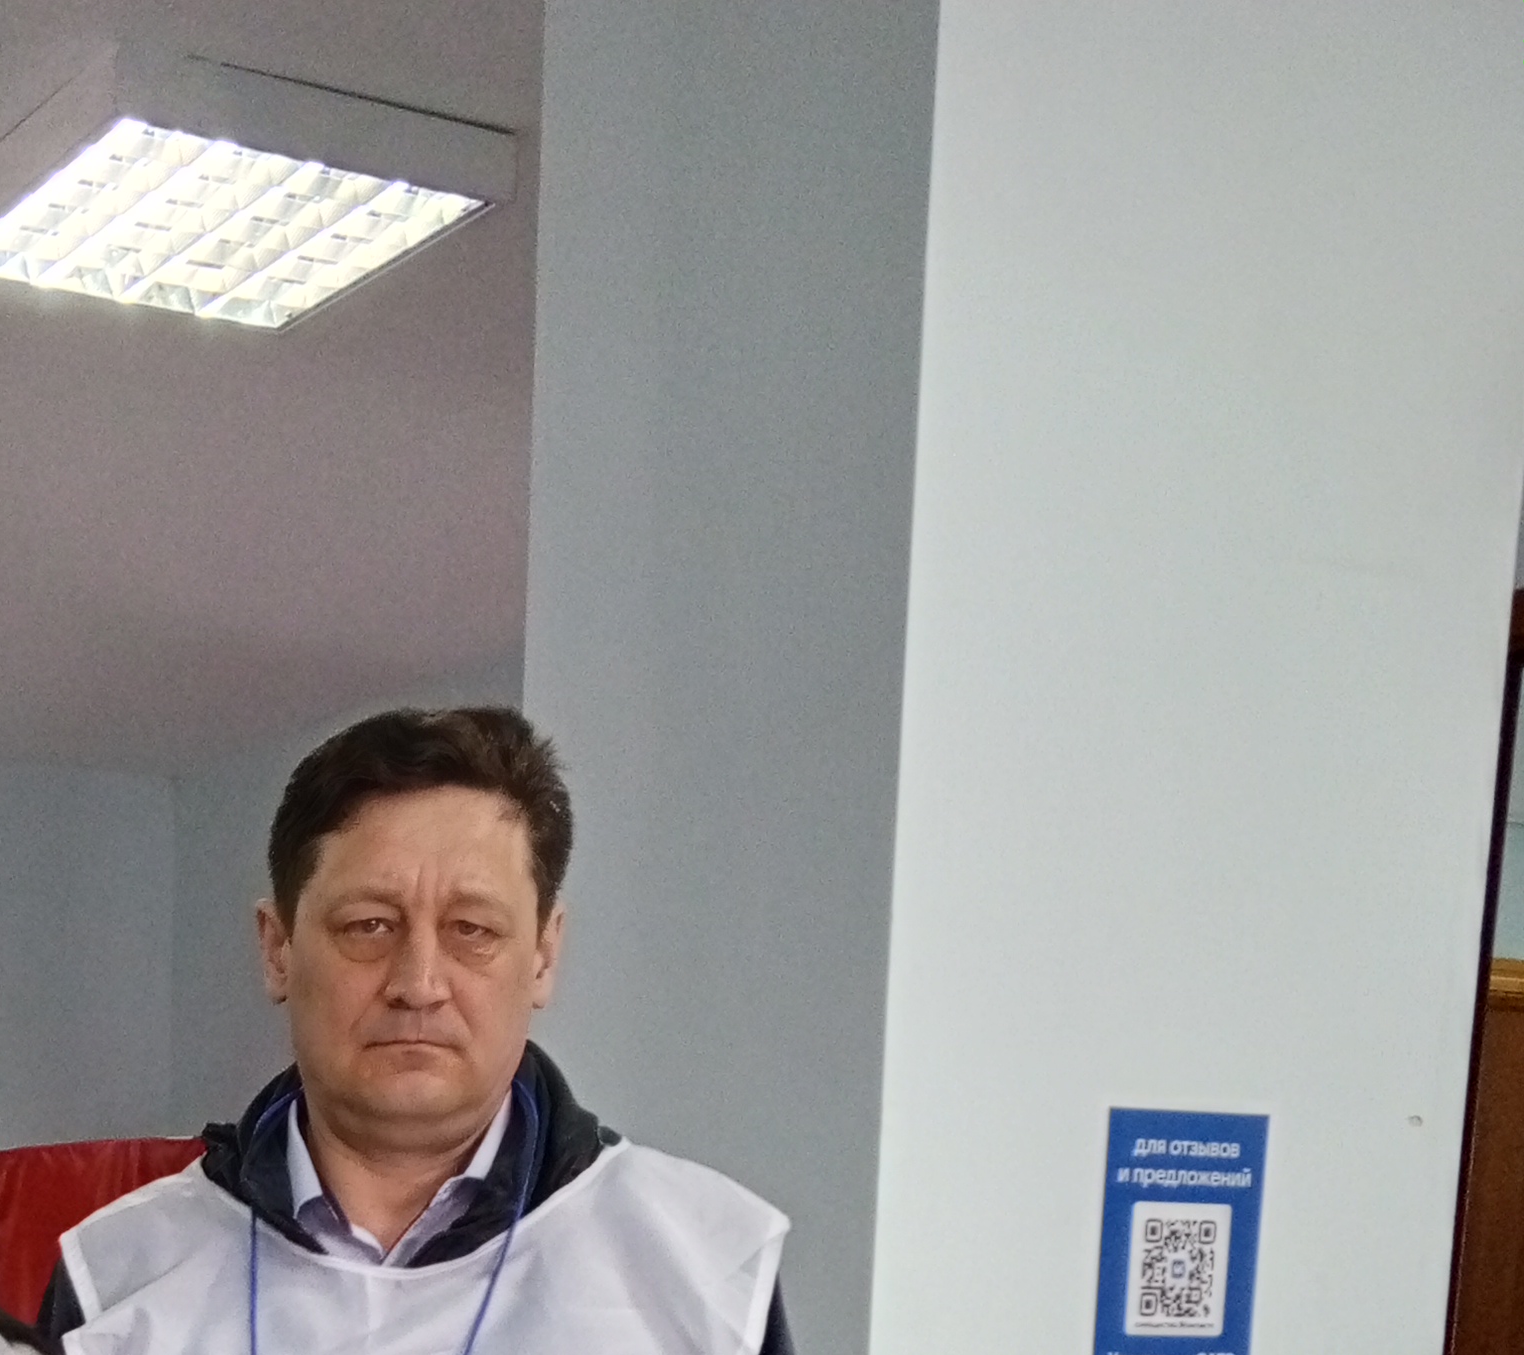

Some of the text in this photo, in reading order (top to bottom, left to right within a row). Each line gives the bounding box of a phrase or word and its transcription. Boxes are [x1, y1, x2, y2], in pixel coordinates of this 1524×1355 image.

[1131, 1138, 1240, 1158] для отзывов
[1117, 1167, 1252, 1188] и предложений
